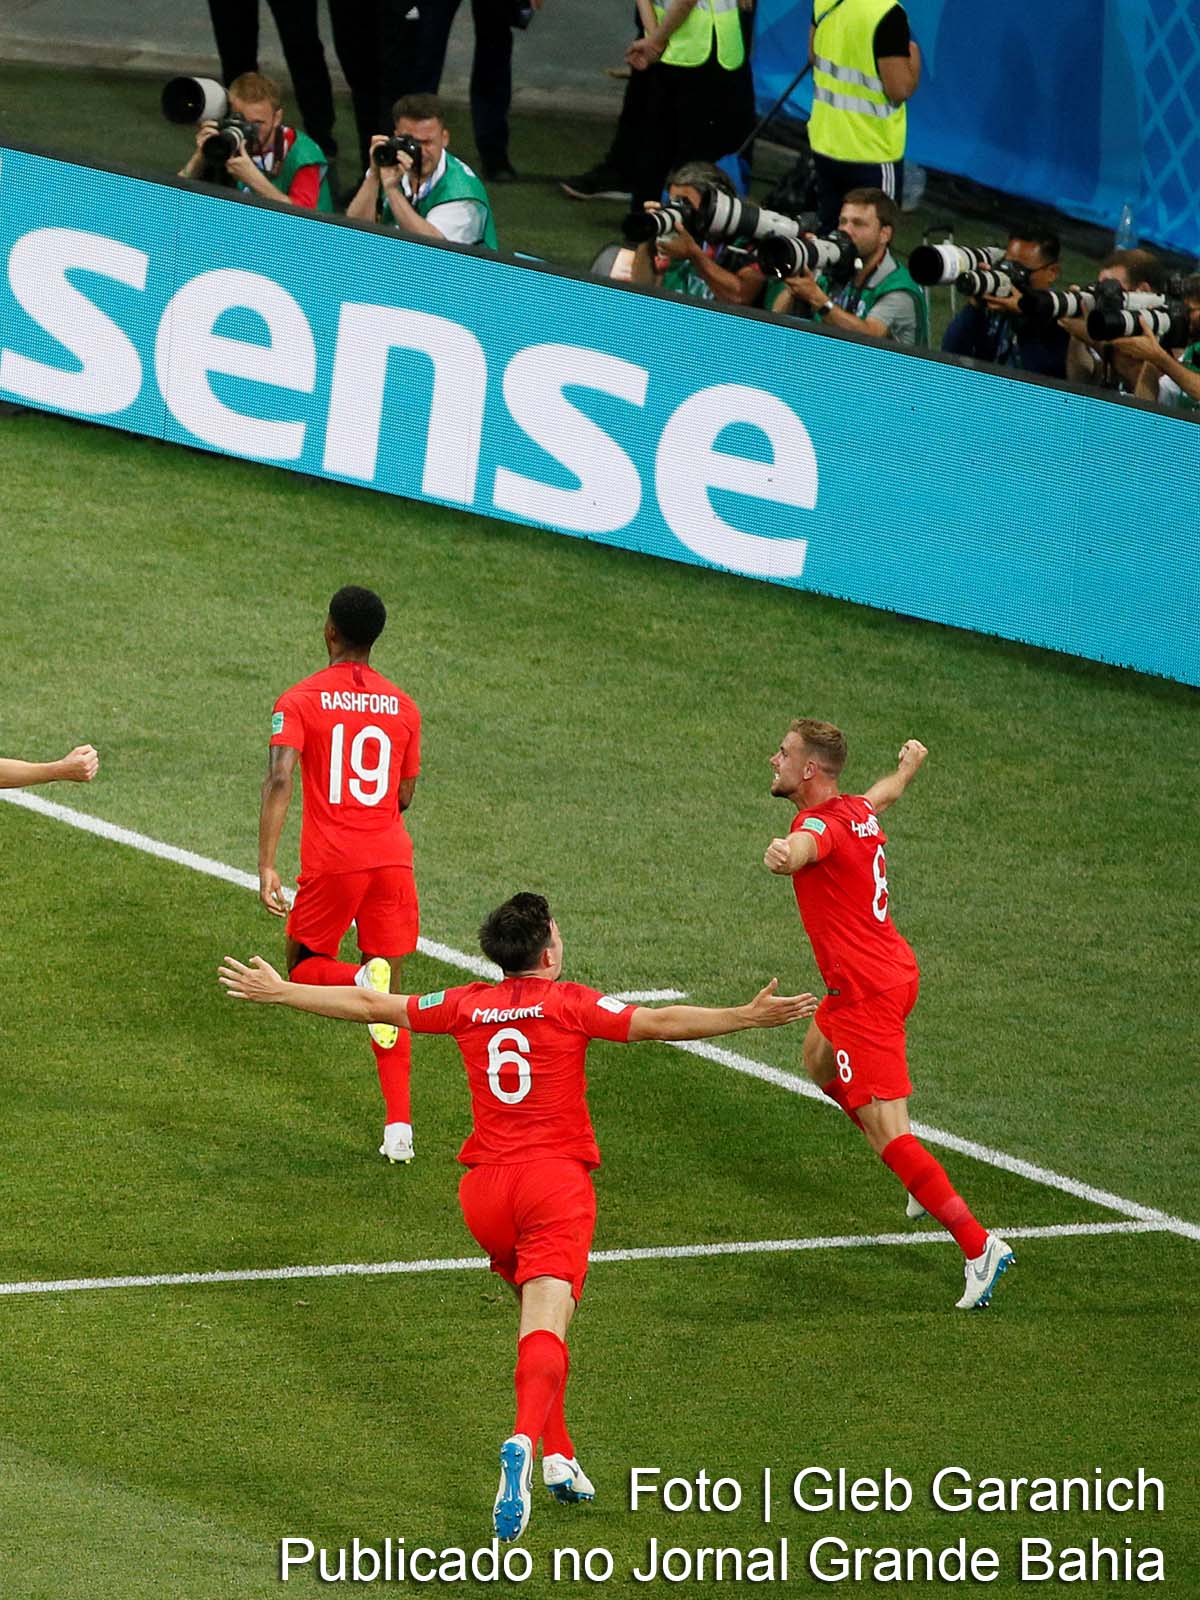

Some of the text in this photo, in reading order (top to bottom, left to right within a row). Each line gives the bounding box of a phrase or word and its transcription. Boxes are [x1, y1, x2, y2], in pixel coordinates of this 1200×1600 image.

[320, 691, 399, 716] RASHFORD
[329, 723, 392, 807] 19
[486, 1027, 532, 1105] 6
[836, 1049, 853, 1084] 8
